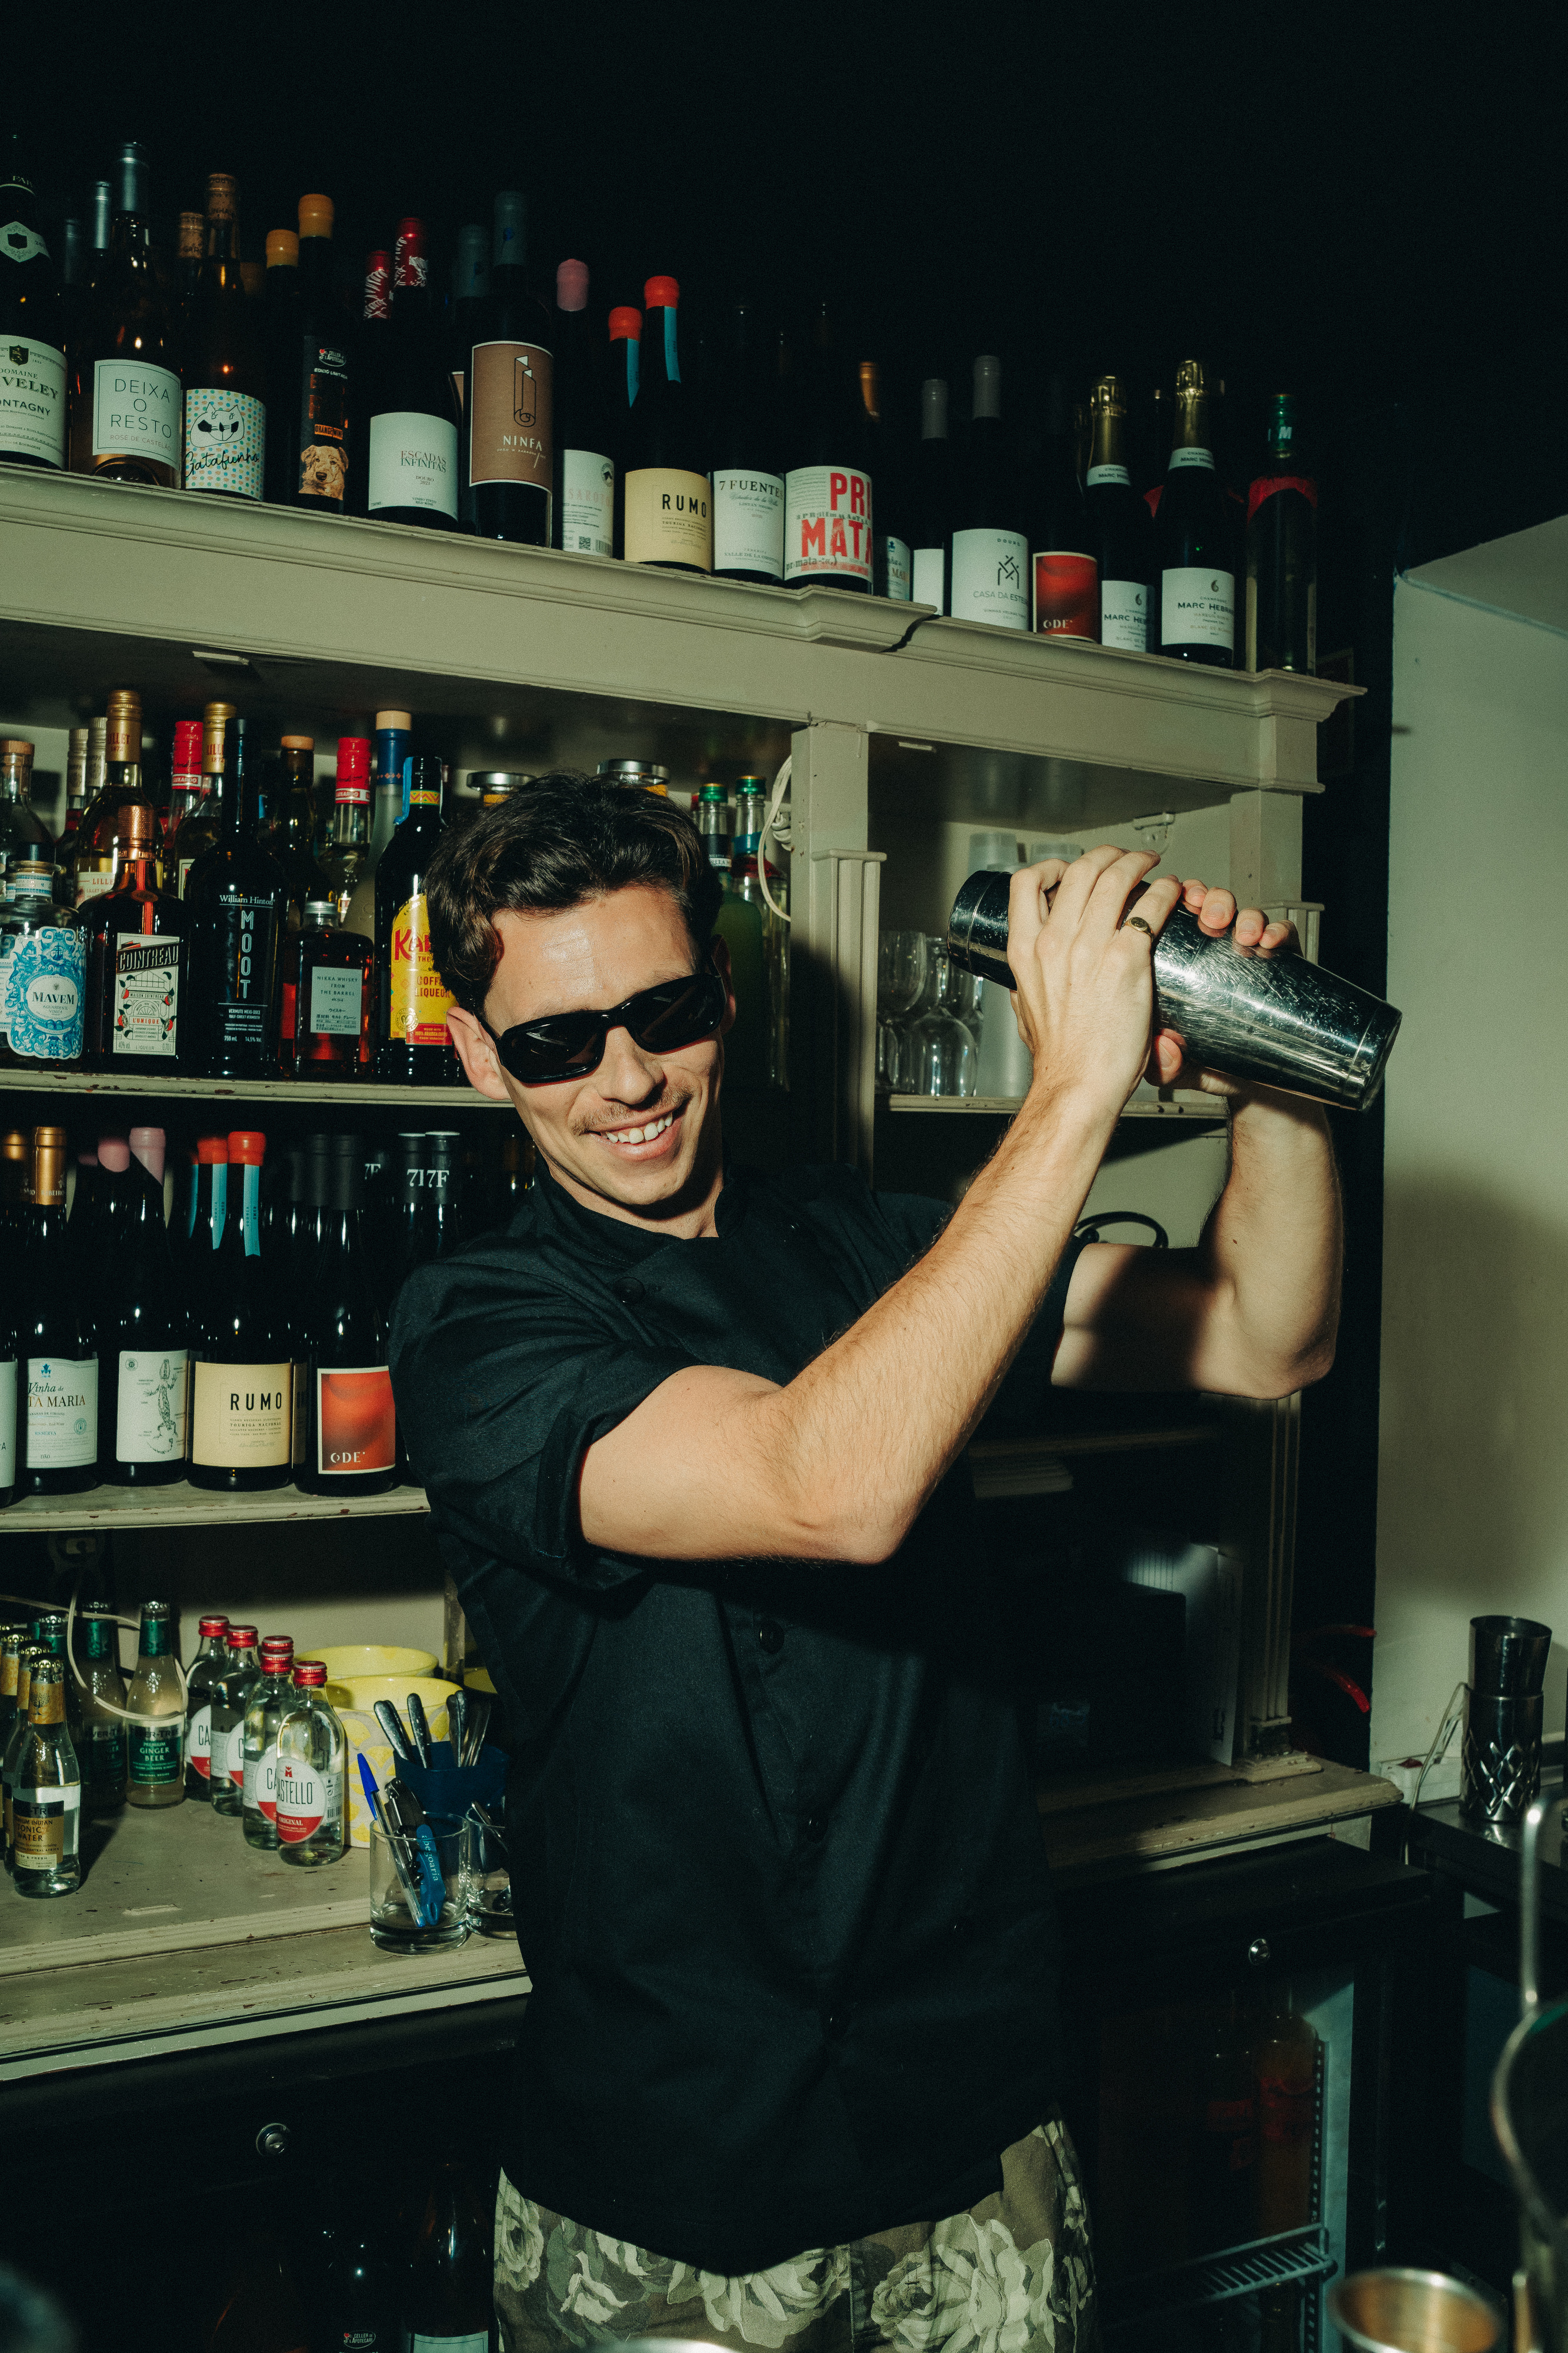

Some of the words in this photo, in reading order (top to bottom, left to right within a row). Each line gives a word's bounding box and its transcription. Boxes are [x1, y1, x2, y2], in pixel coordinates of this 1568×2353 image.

[0, 376, 58, 400] VELEY
[115, 378, 171, 404] DEIXA
[0, 399, 51, 416] NTAGNY
[134, 398, 147, 412] O
[111, 414, 172, 438] RESTO
[503, 435, 542, 452] NINFA
[401, 450, 447, 466] ESCADAS
[401, 458, 447, 474] INFINITAS
[719, 480, 726, 491] 7
[730, 479, 784, 501] FUENTES
[662, 494, 707, 518] RUMO
[997, 591, 1009, 599] DA
[1104, 614, 1130, 622] MARC
[219, 894, 248, 905] William
[249, 895, 275, 906] Hinton
[119, 945, 179, 972] COINTREAU
[239, 909, 254, 999] MOOT
[32, 991, 75, 1005] MAVEM
[426, 1169, 450, 1188] 7F
[28, 1382, 57, 1396] Vinha
[47, 1394, 86, 1408] MARIA
[230, 1392, 282, 1411] RUMO
[18, 1824, 42, 1834] TONIC
[18, 1832, 44, 1842] WATER
